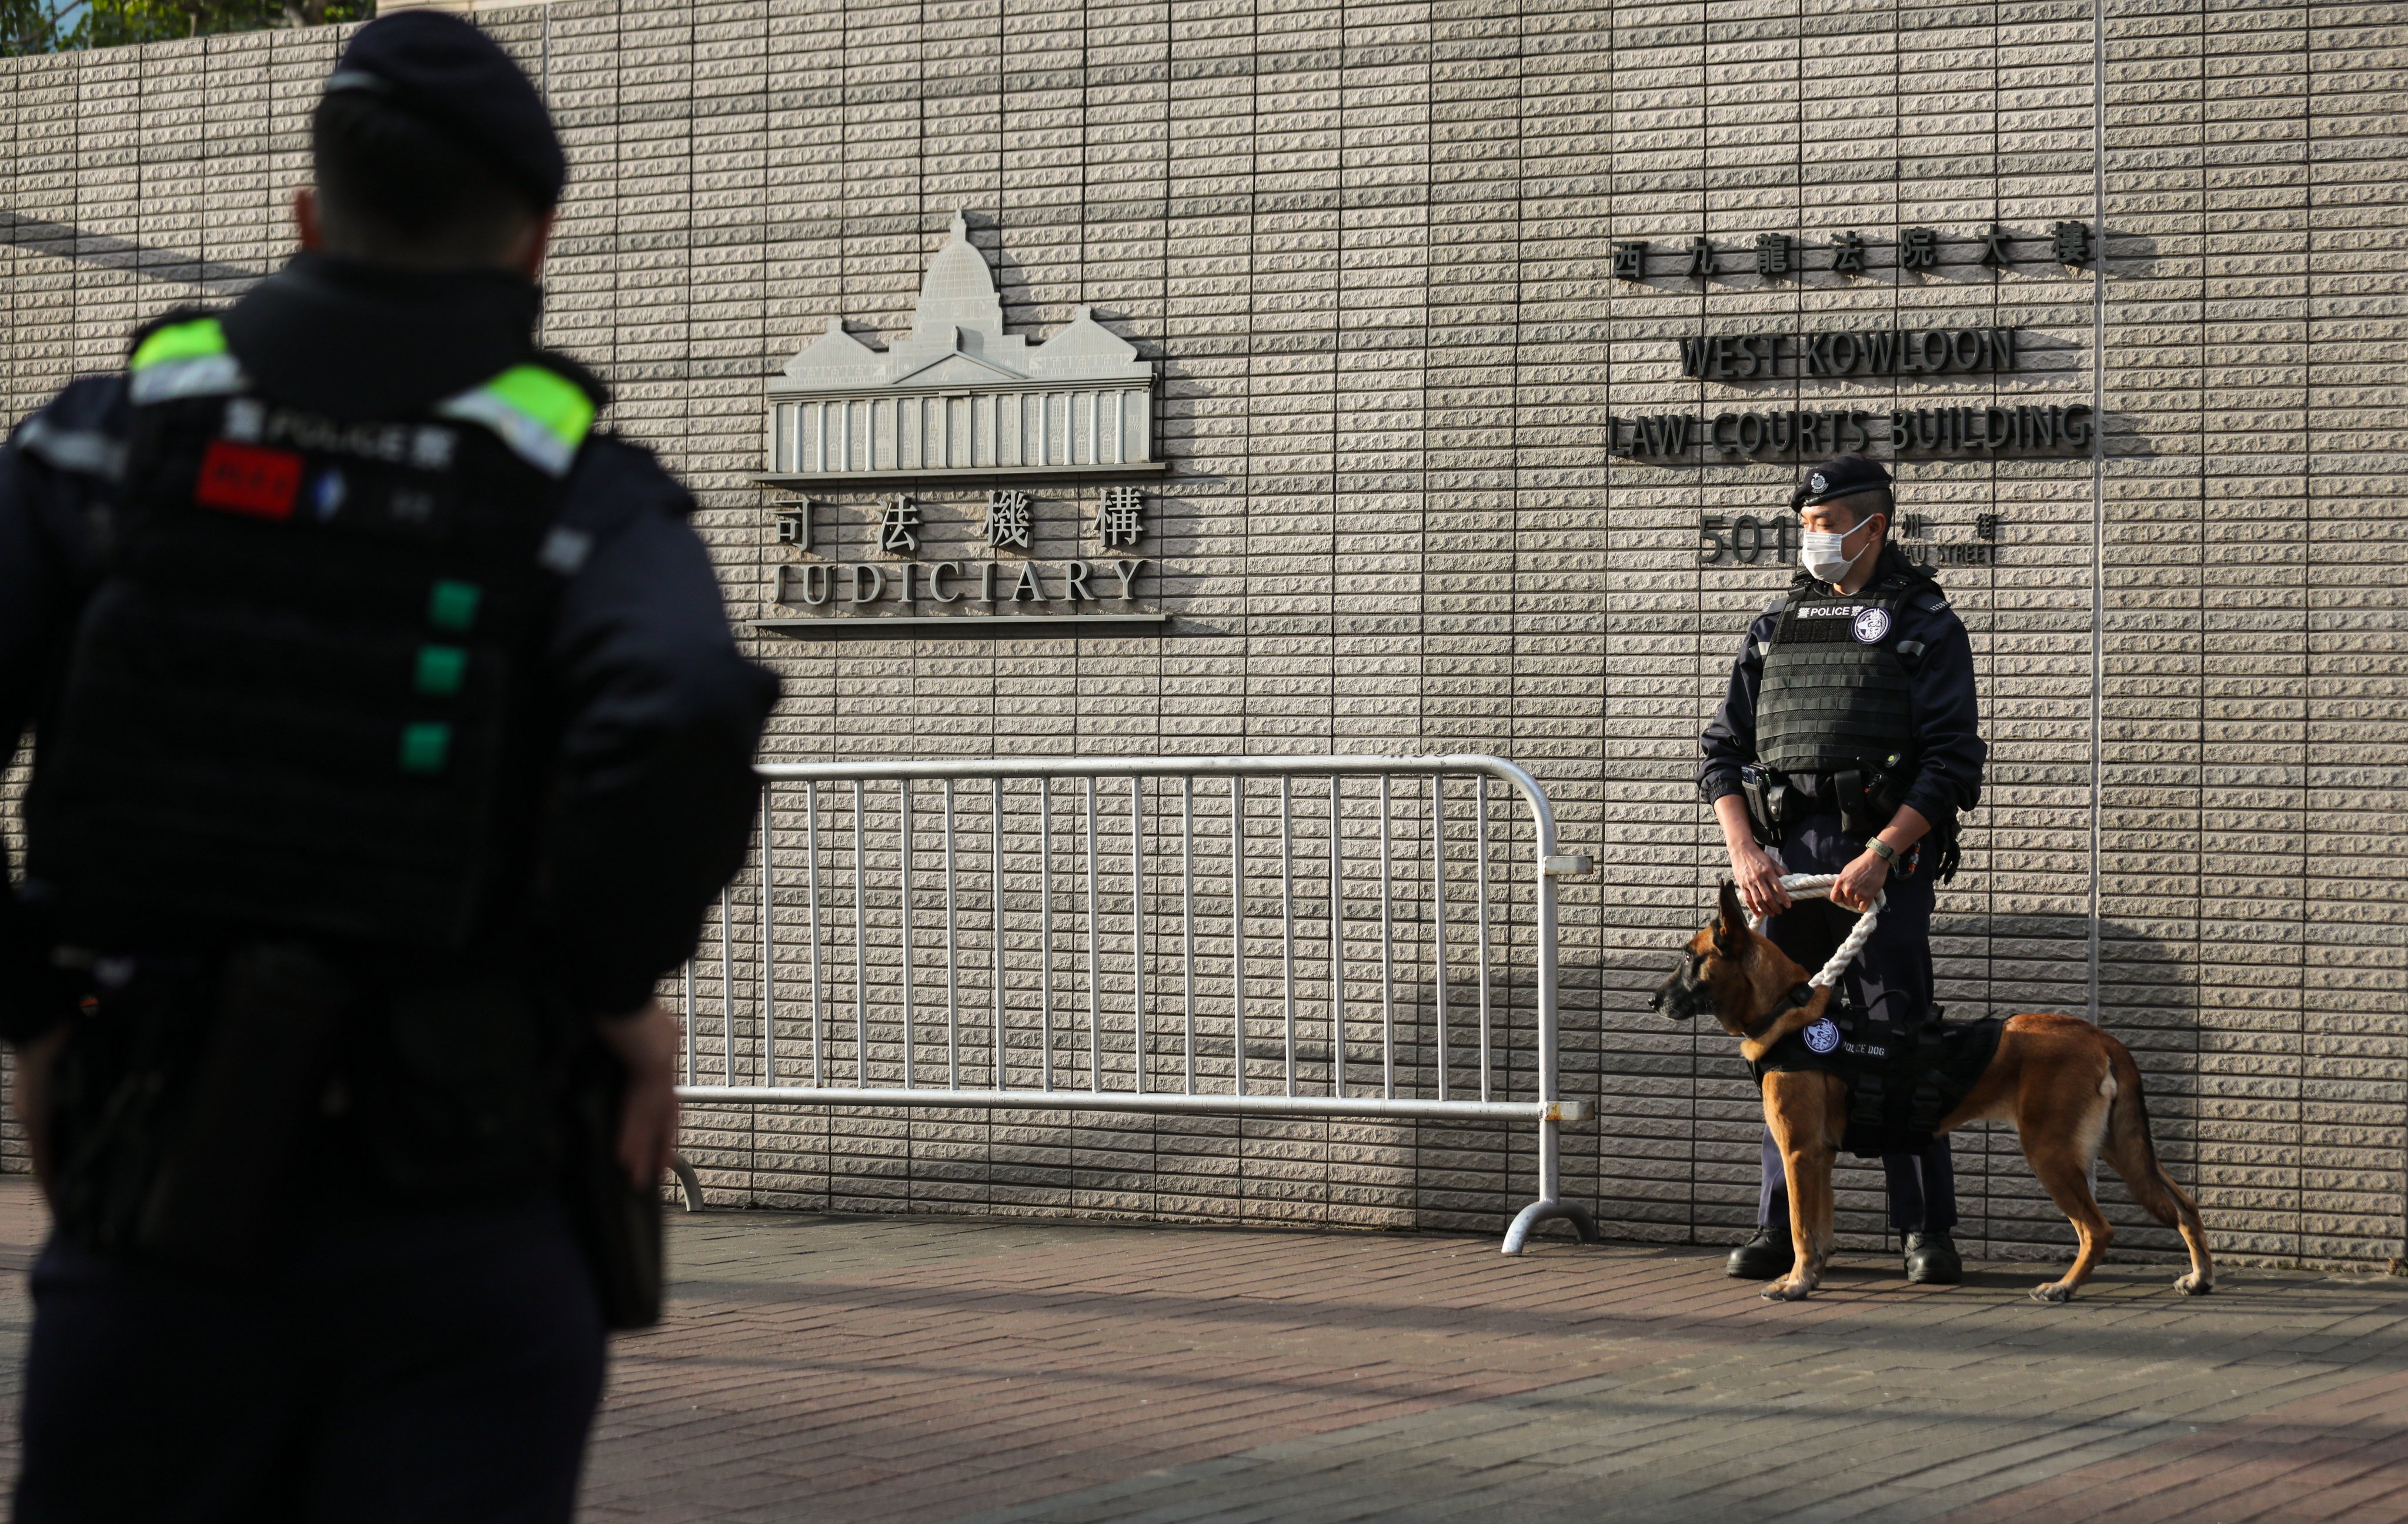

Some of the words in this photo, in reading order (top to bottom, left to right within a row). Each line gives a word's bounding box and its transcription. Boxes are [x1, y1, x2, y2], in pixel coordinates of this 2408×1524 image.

[1611, 220, 2089, 278] 西九龍法院大樓
[1679, 333, 1785, 376] WEST
[1805, 326, 2015, 373] KOWLOON
[1609, 414, 1692, 456] LAW
[1711, 410, 1870, 453] COURTS
[1890, 403, 2090, 450] BUILDING
[774, 486, 1144, 552] 司法機構
[1696, 515, 1785, 563] 501
[1936, 544, 1995, 563] STREET
[766, 560, 1147, 605] JUDICIARY
[1810, 606, 1851, 617] POLICE
[1868, 1045, 1885, 1057] DOG
